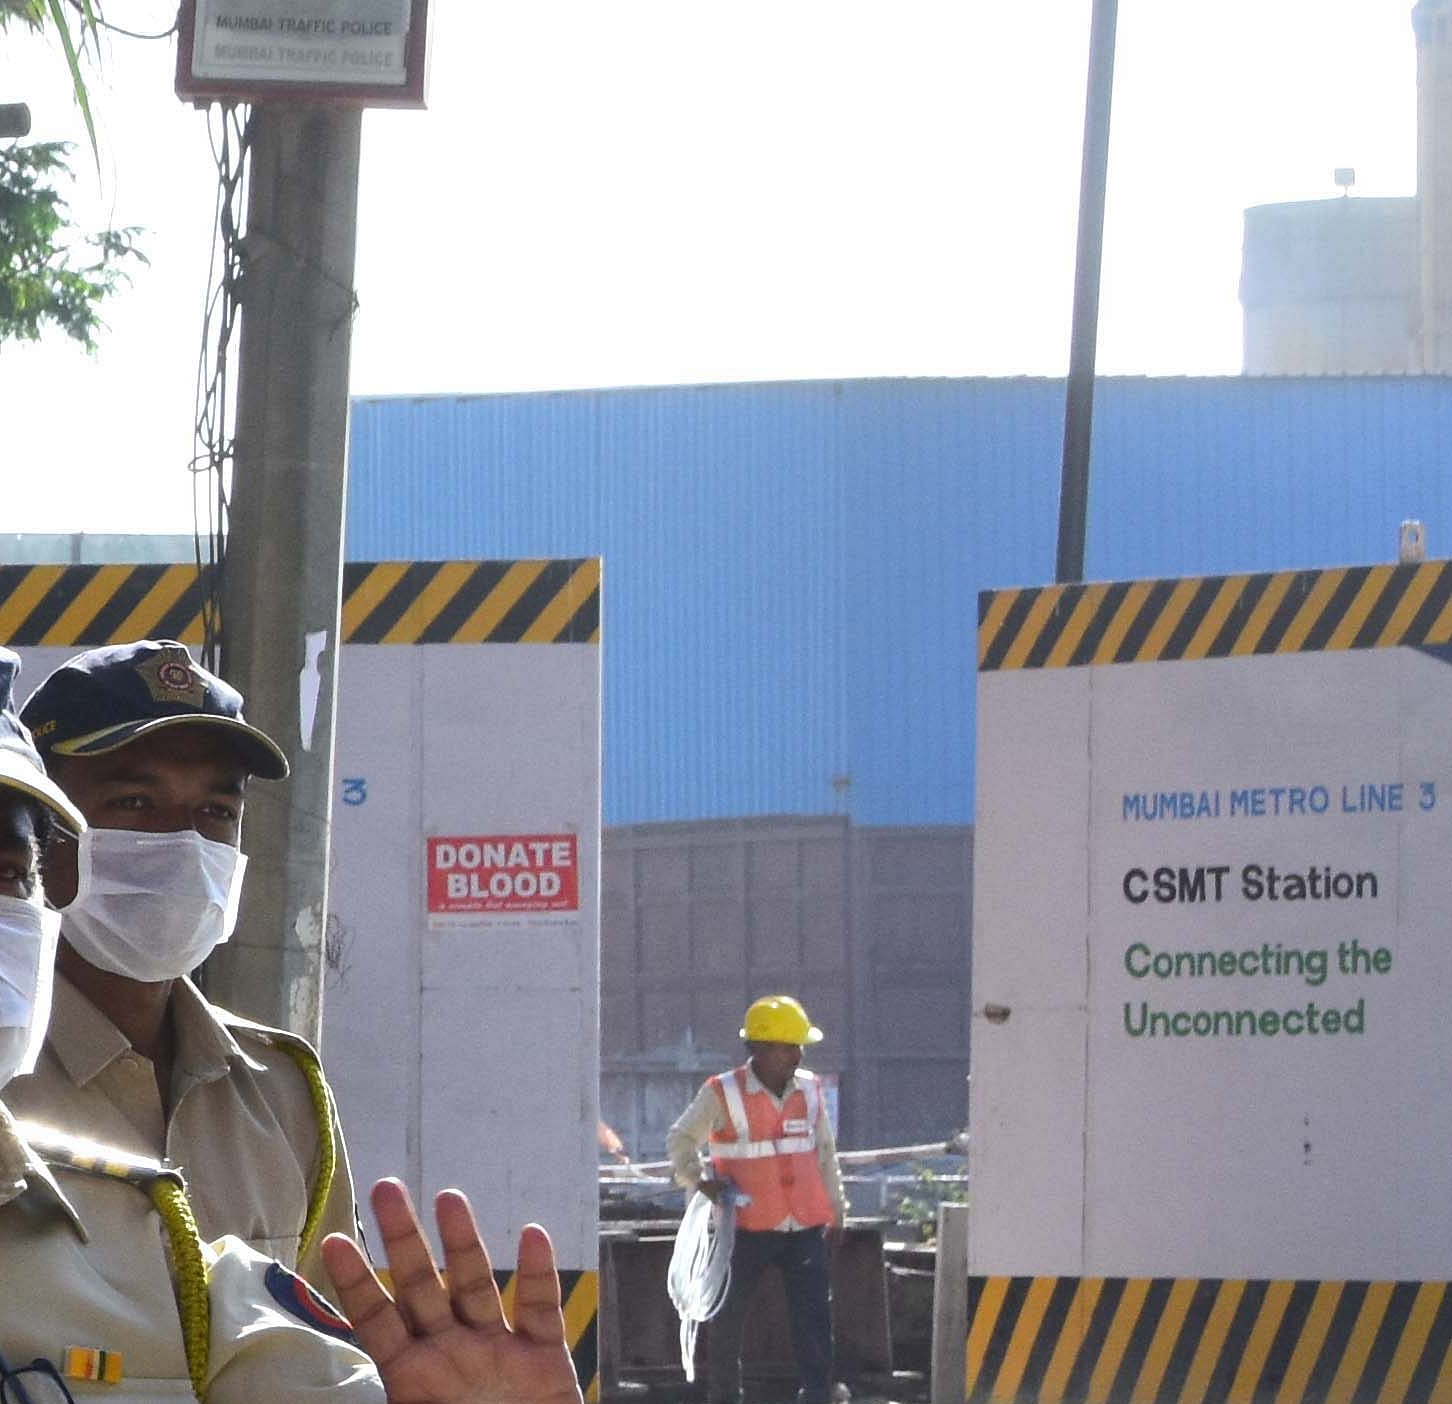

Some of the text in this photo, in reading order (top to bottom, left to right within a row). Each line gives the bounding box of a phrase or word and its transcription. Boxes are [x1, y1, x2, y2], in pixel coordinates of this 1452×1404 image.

[216, 16, 392, 36] MUMBAI TRAFFIC POLICE
[341, 778, 367, 806] 3
[1122, 781, 1437, 821] MUMBAI METRO LINE 3
[435, 841, 571, 869] DONATE
[447, 871, 562, 898] BLOOD
[1122, 864, 1378, 904] CSMT Station
[1124, 939, 1392, 986] Connecting the
[1123, 999, 1365, 1038] Unconnected
